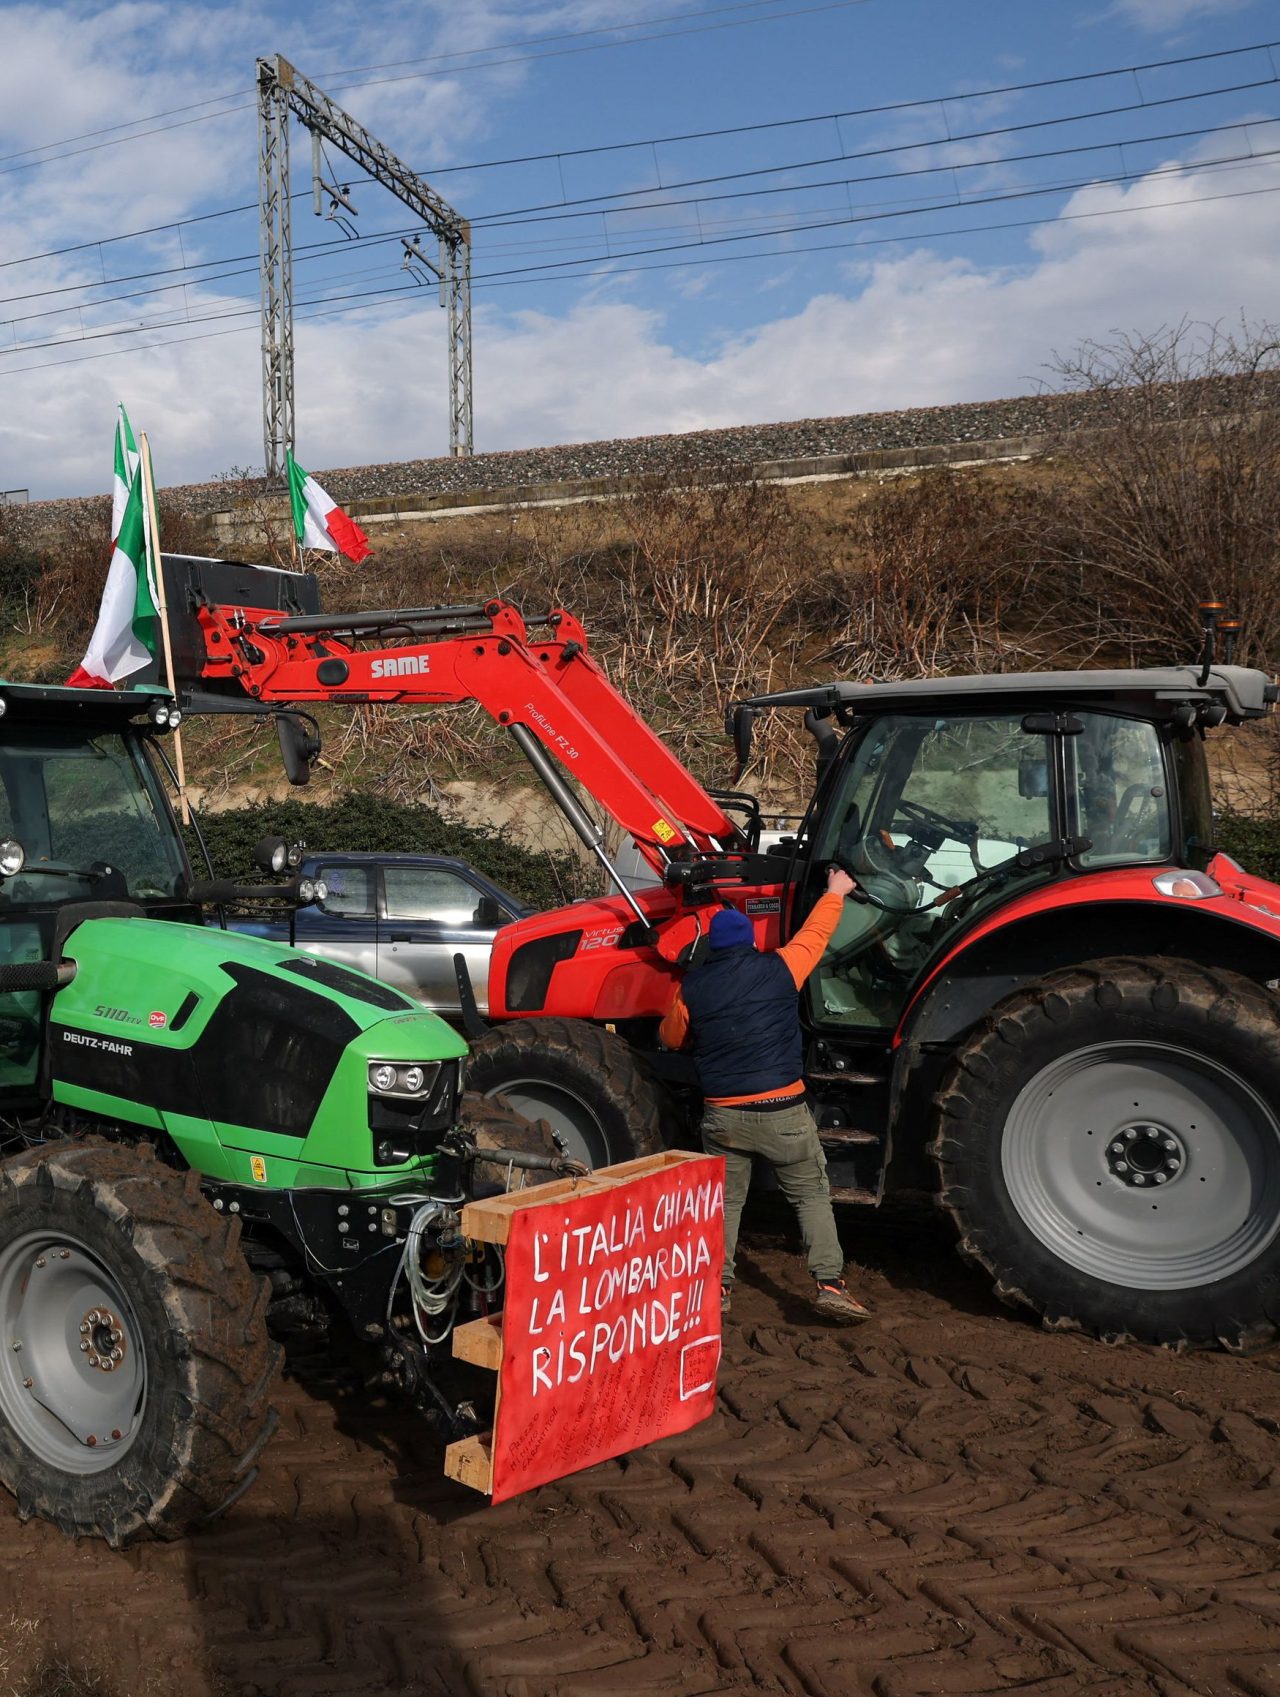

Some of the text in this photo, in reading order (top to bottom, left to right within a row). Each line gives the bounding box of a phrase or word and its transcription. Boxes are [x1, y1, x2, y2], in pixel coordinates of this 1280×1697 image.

[371, 655, 429, 678] SAME
[524, 703, 579, 759] ProfiLine FZ 30
[581, 934, 620, 950] 120
[93, 1005, 129, 1021] 5110
[63, 1031, 133, 1056] DEUTZ-FAHR
[529, 1289, 566, 1335] LA
